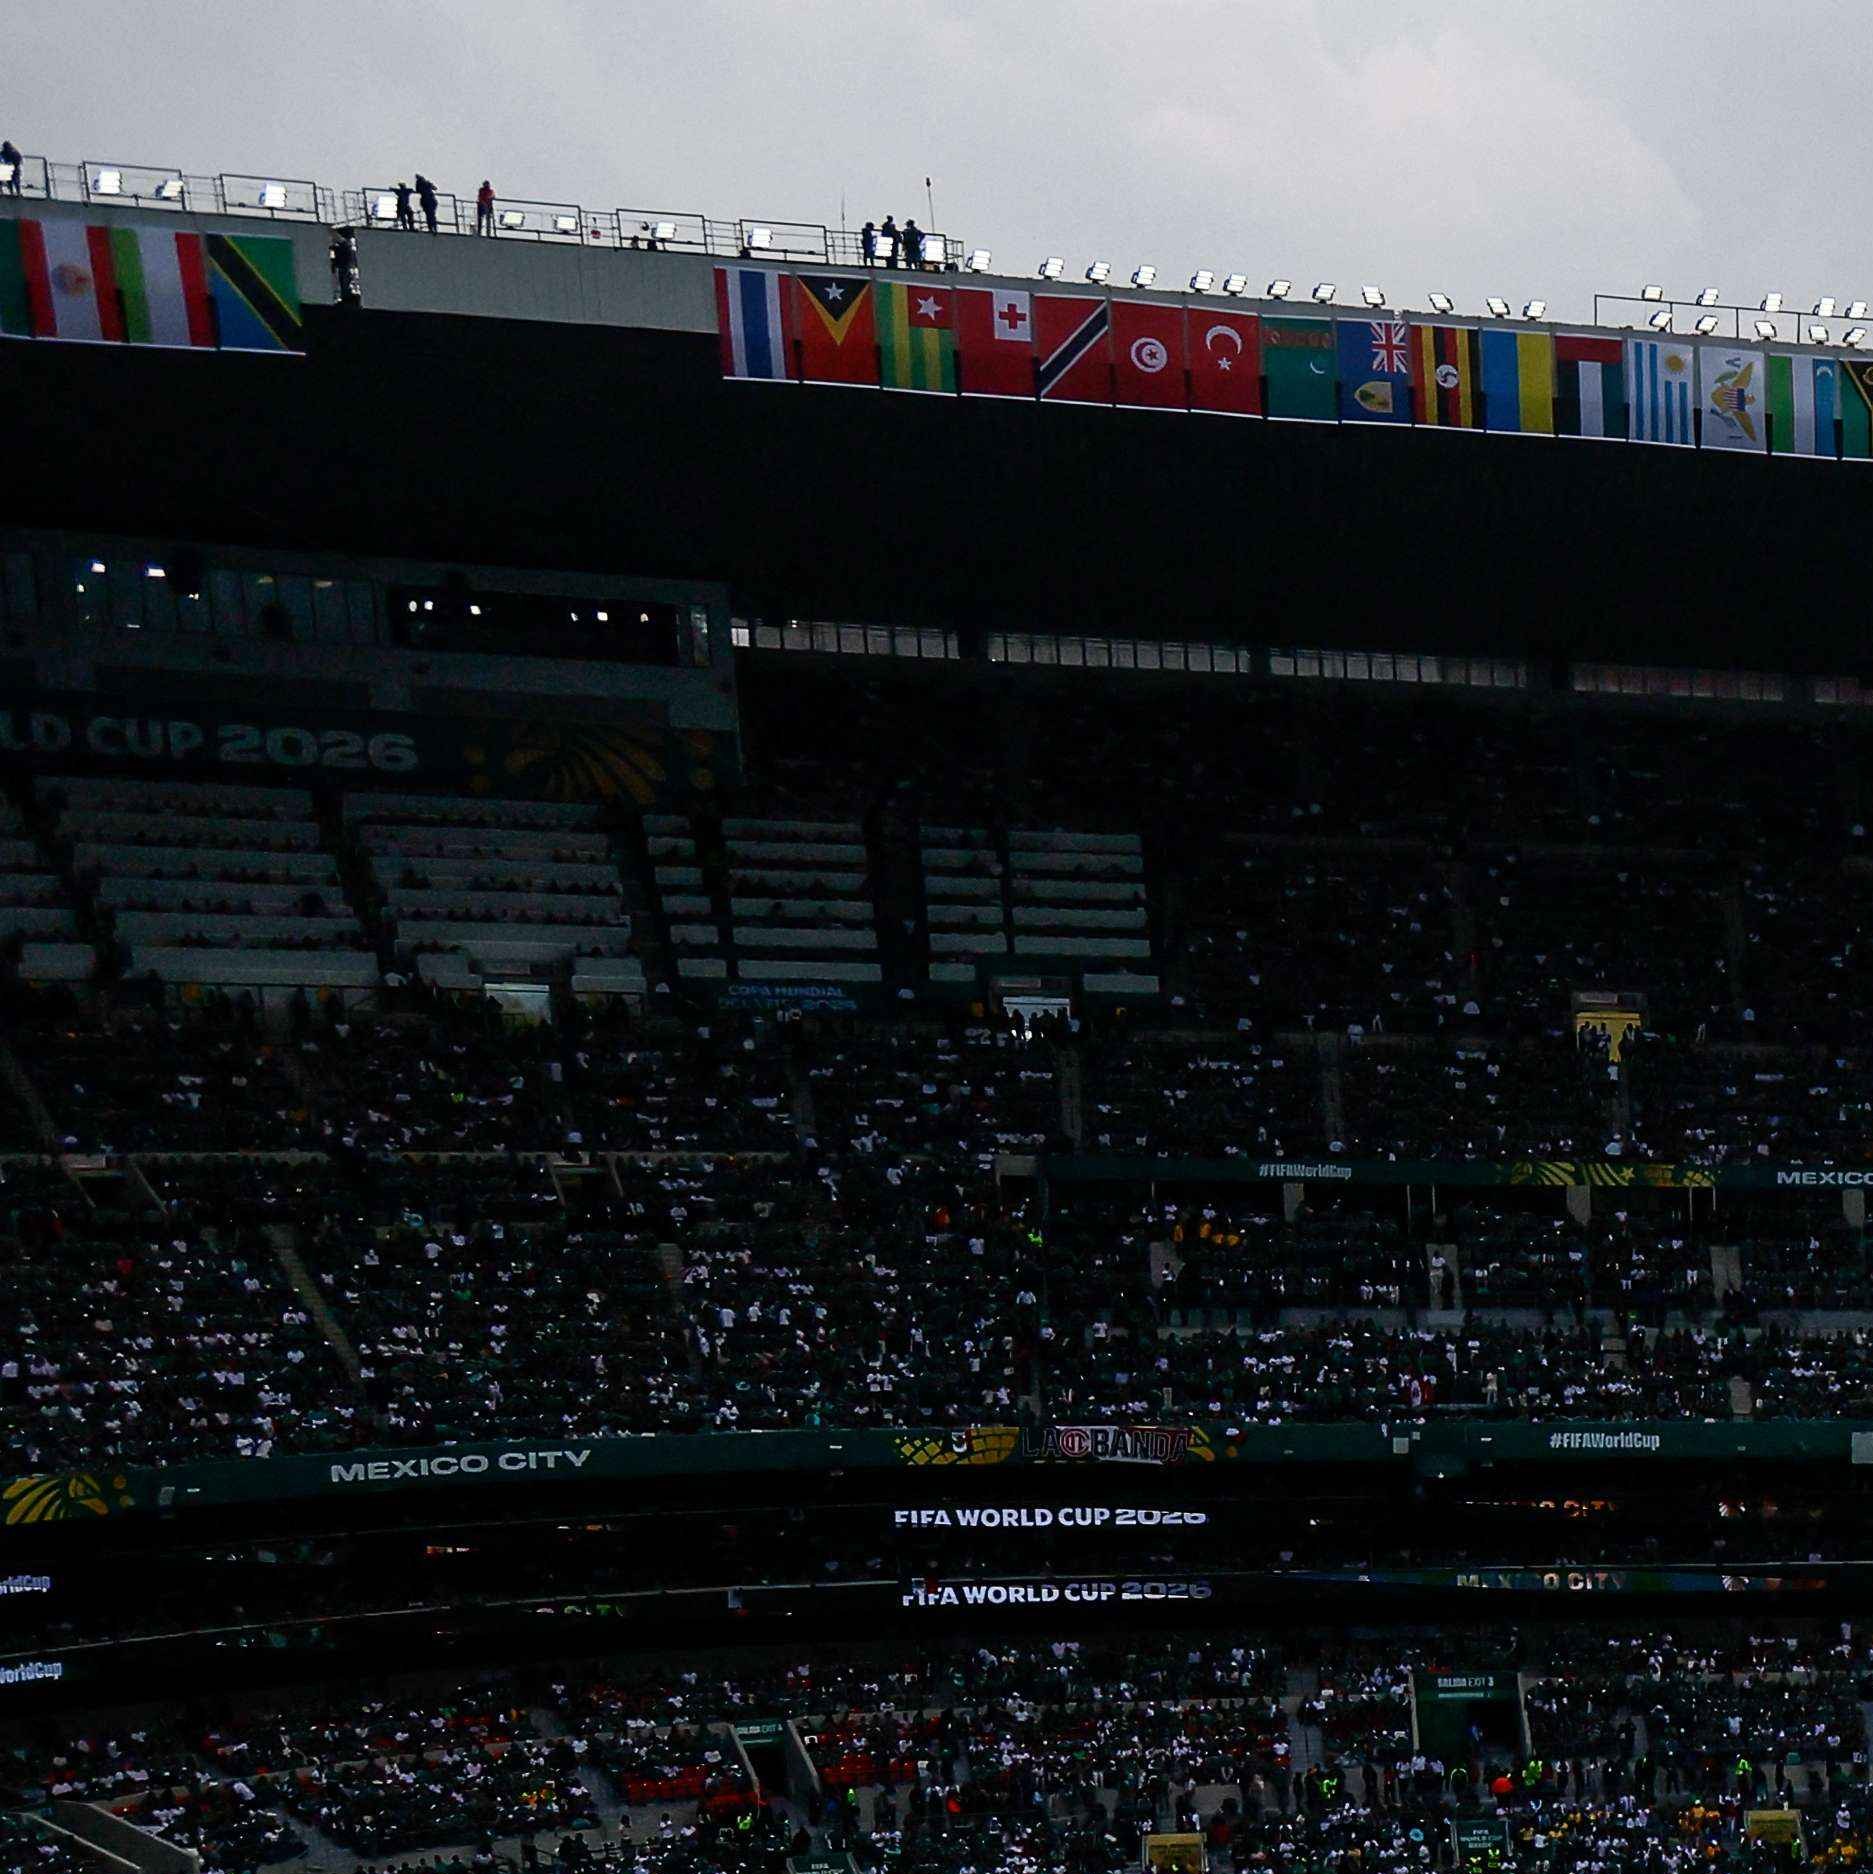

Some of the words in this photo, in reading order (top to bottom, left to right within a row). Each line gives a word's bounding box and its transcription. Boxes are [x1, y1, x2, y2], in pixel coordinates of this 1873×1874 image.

[86, 714, 202, 758] CUP
[217, 721, 419, 774] 2026
[1550, 1431, 1661, 1452] #FIFAWorldCup
[330, 1454, 489, 1483] MEXICO
[498, 1449, 592, 1472] CITY
[895, 1509, 952, 1528] FIFA
[956, 1509, 1053, 1527] WORLD
[1058, 1508, 1110, 1527] CUP
[1114, 1510, 1208, 1527] 2026
[958, 1585, 1059, 1604] WORLD
[1063, 1583, 1116, 1602] CUP
[1120, 1582, 1213, 1601] 2026
